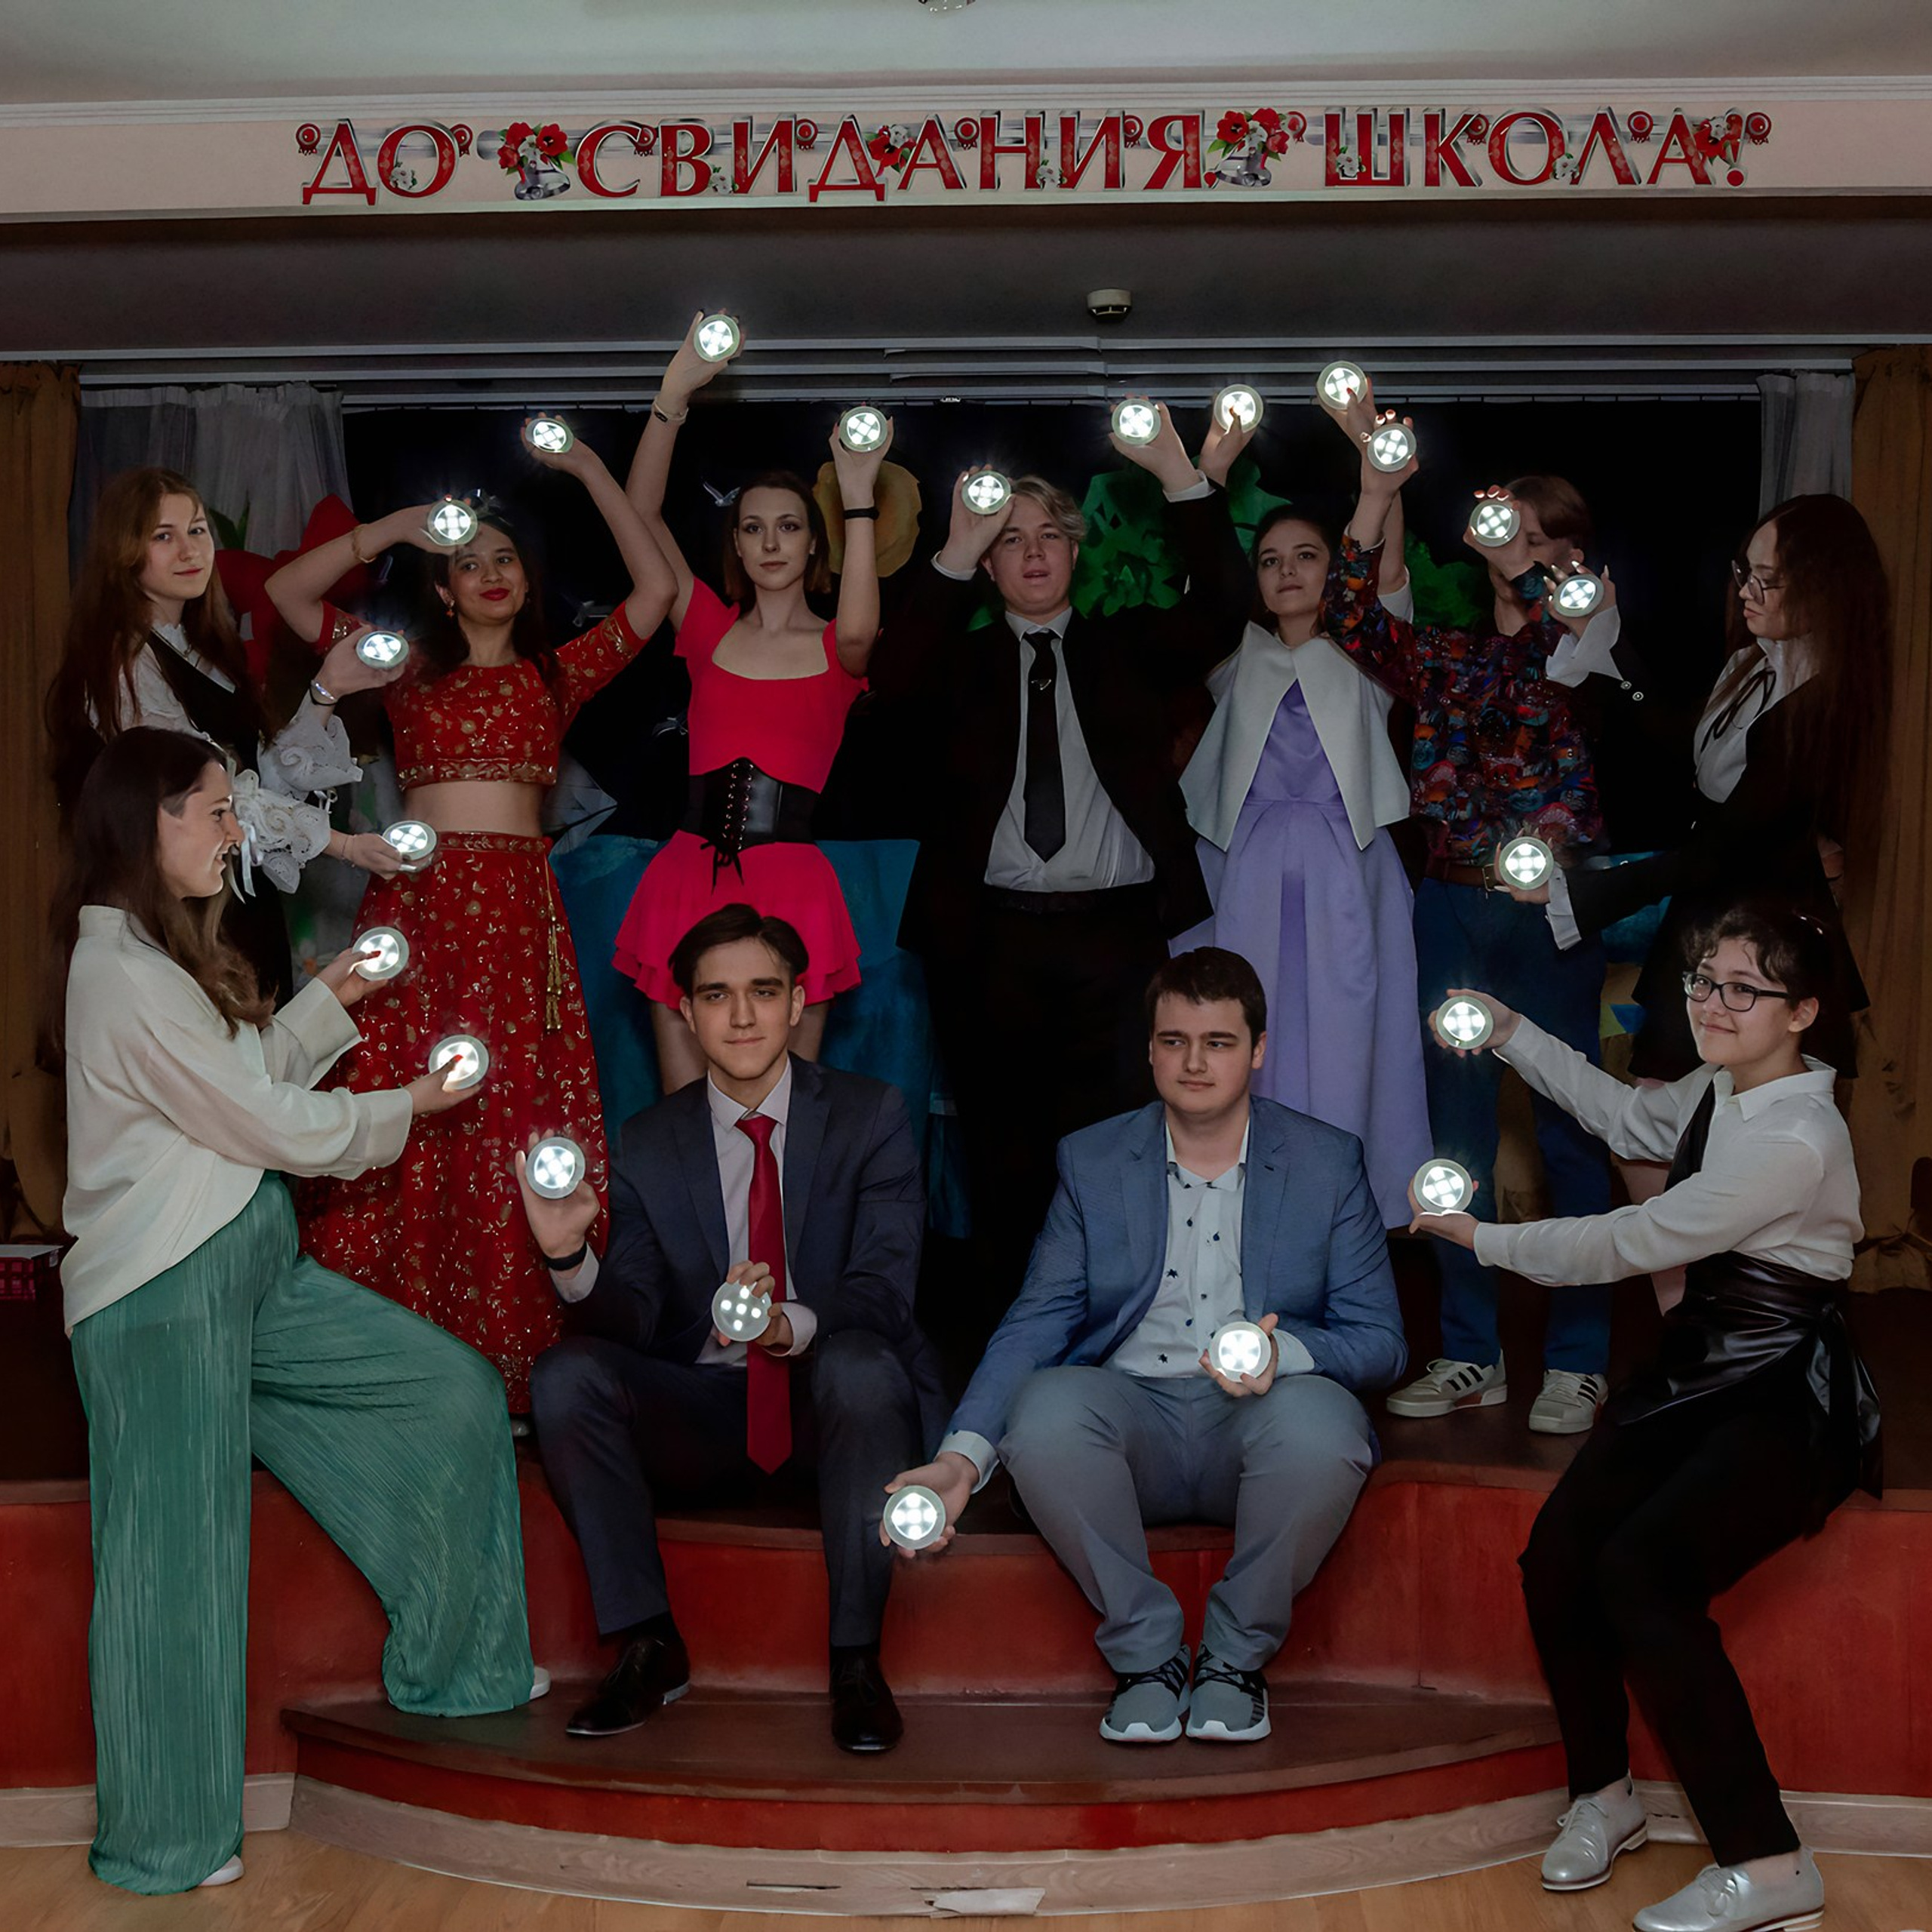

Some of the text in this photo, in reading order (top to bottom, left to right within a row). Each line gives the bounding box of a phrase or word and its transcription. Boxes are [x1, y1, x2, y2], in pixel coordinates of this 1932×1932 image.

[302, 108, 1749, 206] ДО СВИДАНИЯ ШКОЛА!
